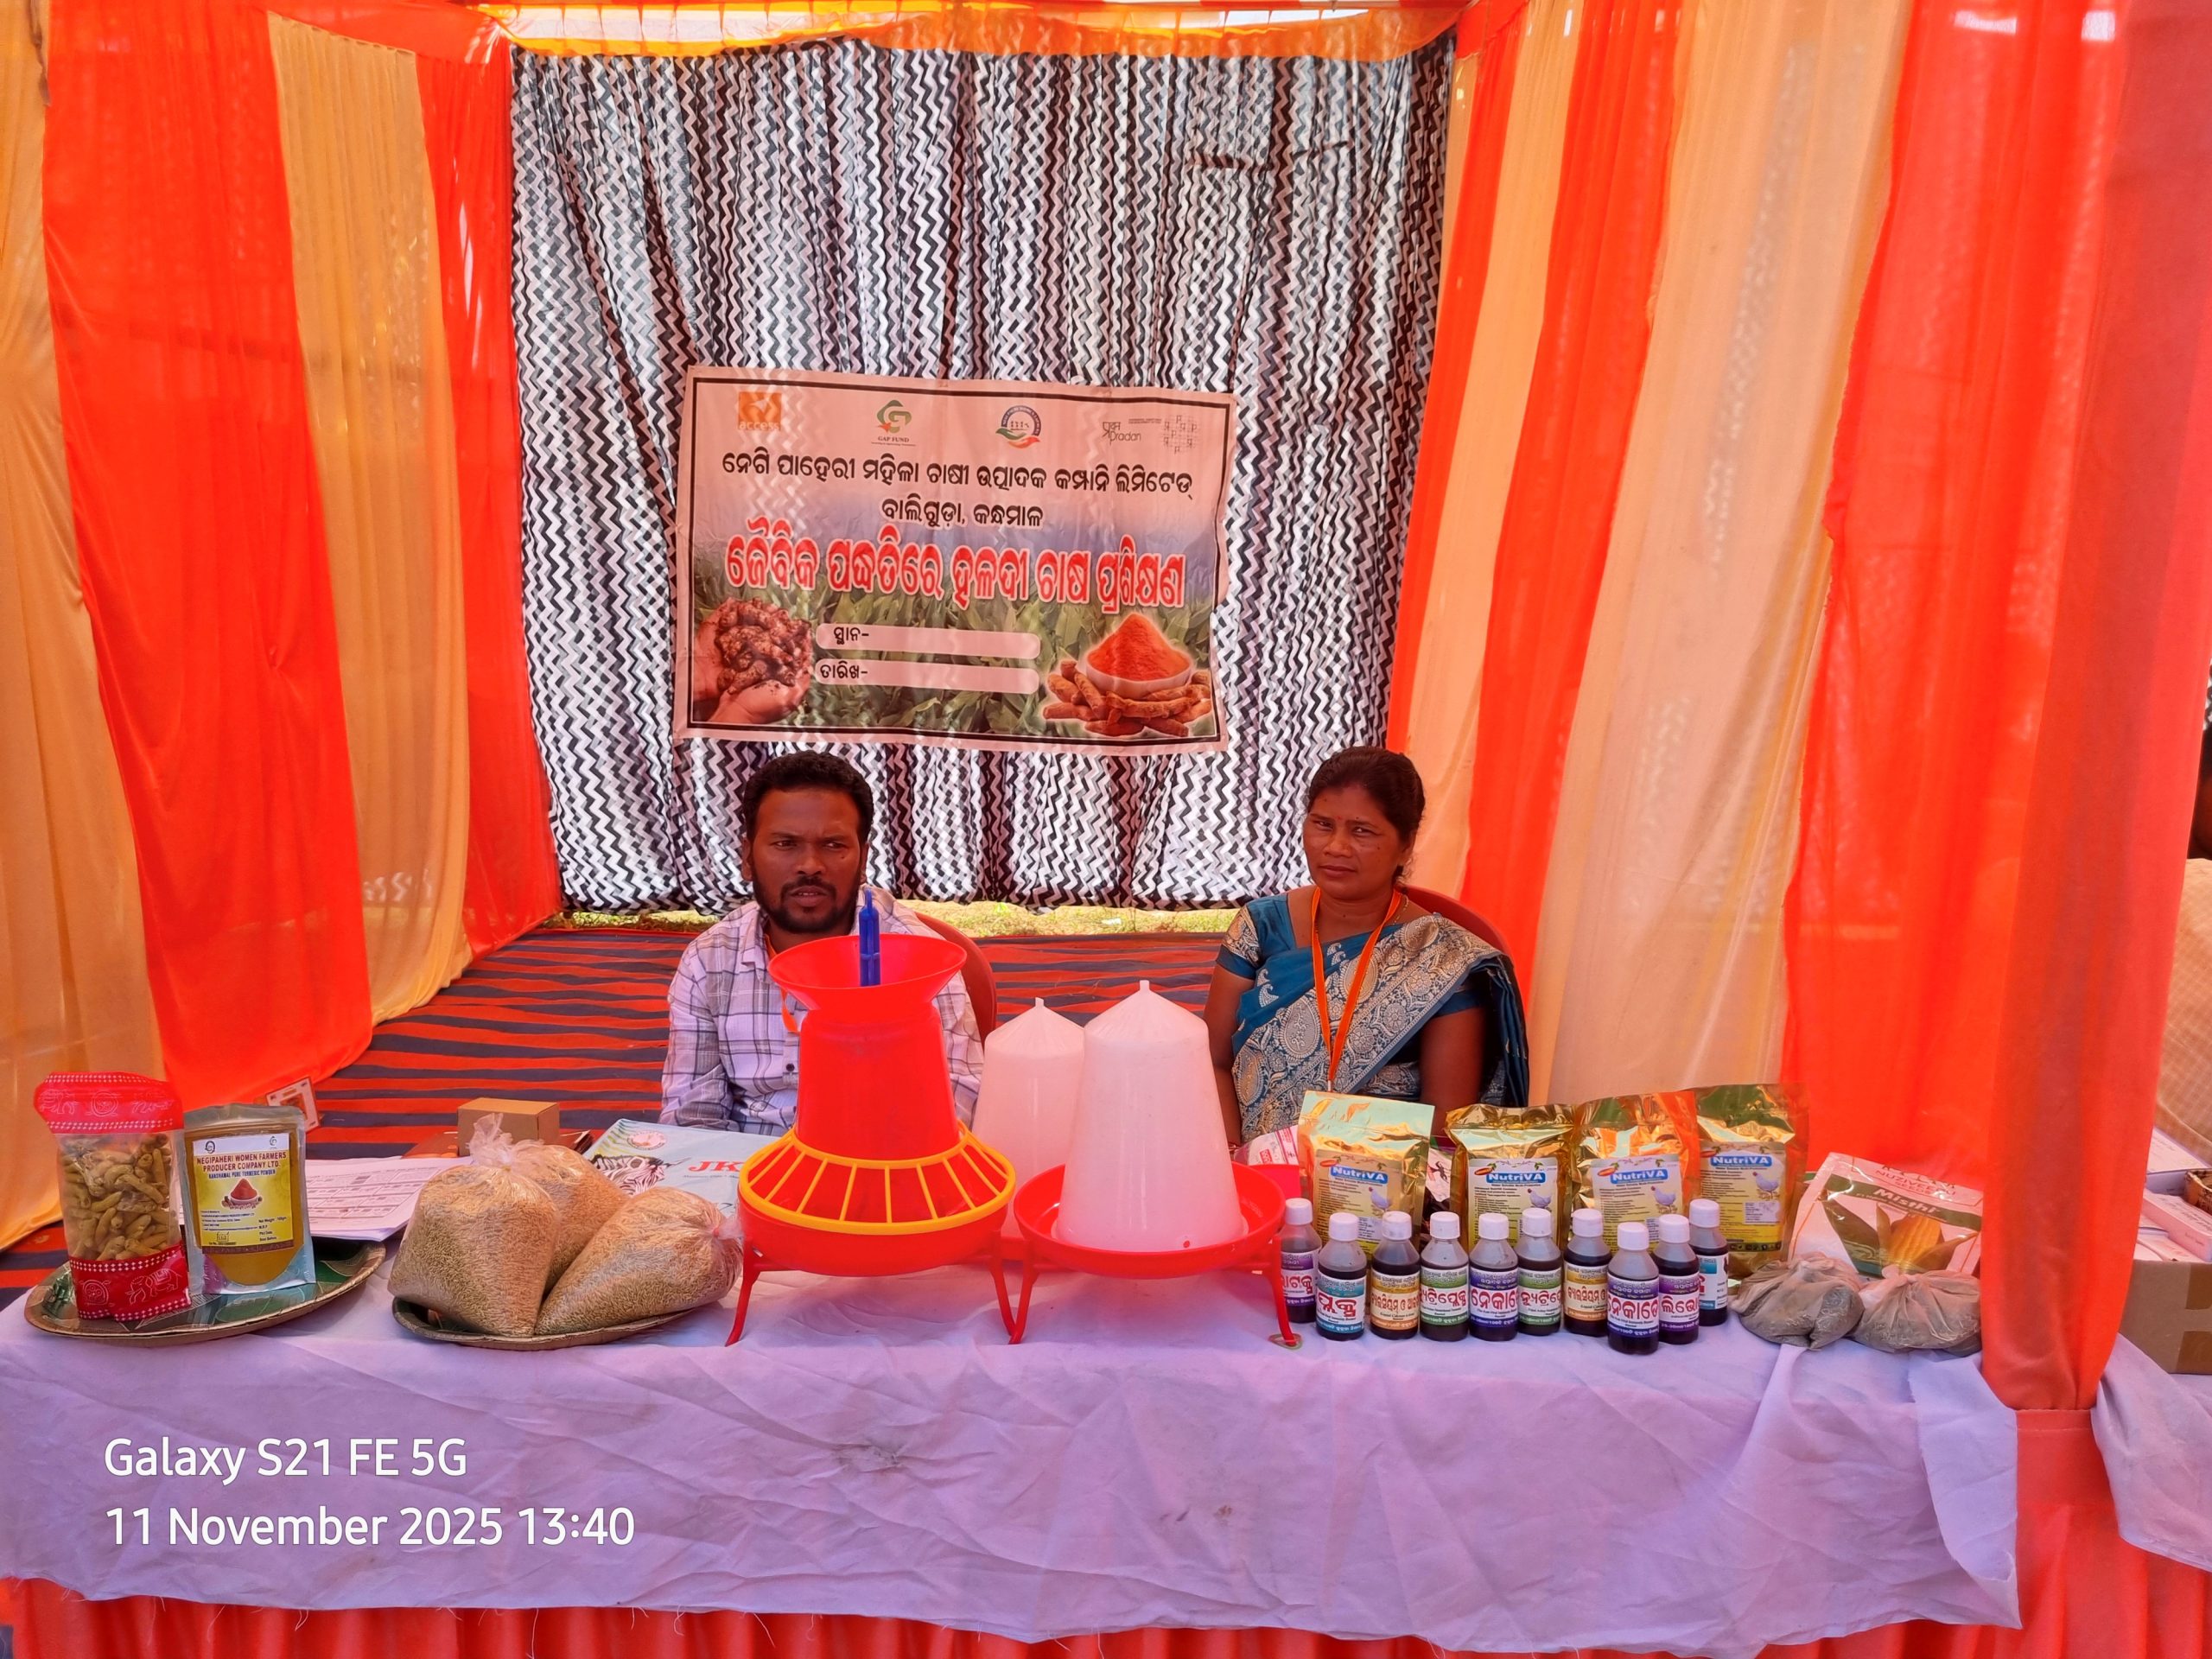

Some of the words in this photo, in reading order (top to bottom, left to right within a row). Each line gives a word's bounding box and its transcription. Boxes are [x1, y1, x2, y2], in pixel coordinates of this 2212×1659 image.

[739, 421, 781, 430] access
[722, 446, 770, 474] ନେଗି
[778, 454, 855, 482] ପାହେରୀ
[862, 453, 919, 486] ମହିଳା
[926, 461, 969, 485] ଚାଷୀ
[727, 517, 819, 590] ଜୈବିକ
[1037, 550, 1090, 603] ଚାଷ
[197, 1155, 233, 1165] NEGIPAHERI
[259, 1152, 287, 1161] FARMERS
[203, 1163, 236, 1172] PRODUCER
[238, 1162, 265, 1171] COMPANY
[688, 1160, 744, 1172] JK
[1332, 1166, 1385, 1180] NutriVA
[1612, 1169, 1666, 1181] NutriVA
[1873, 1188, 1937, 1213] Misthi
